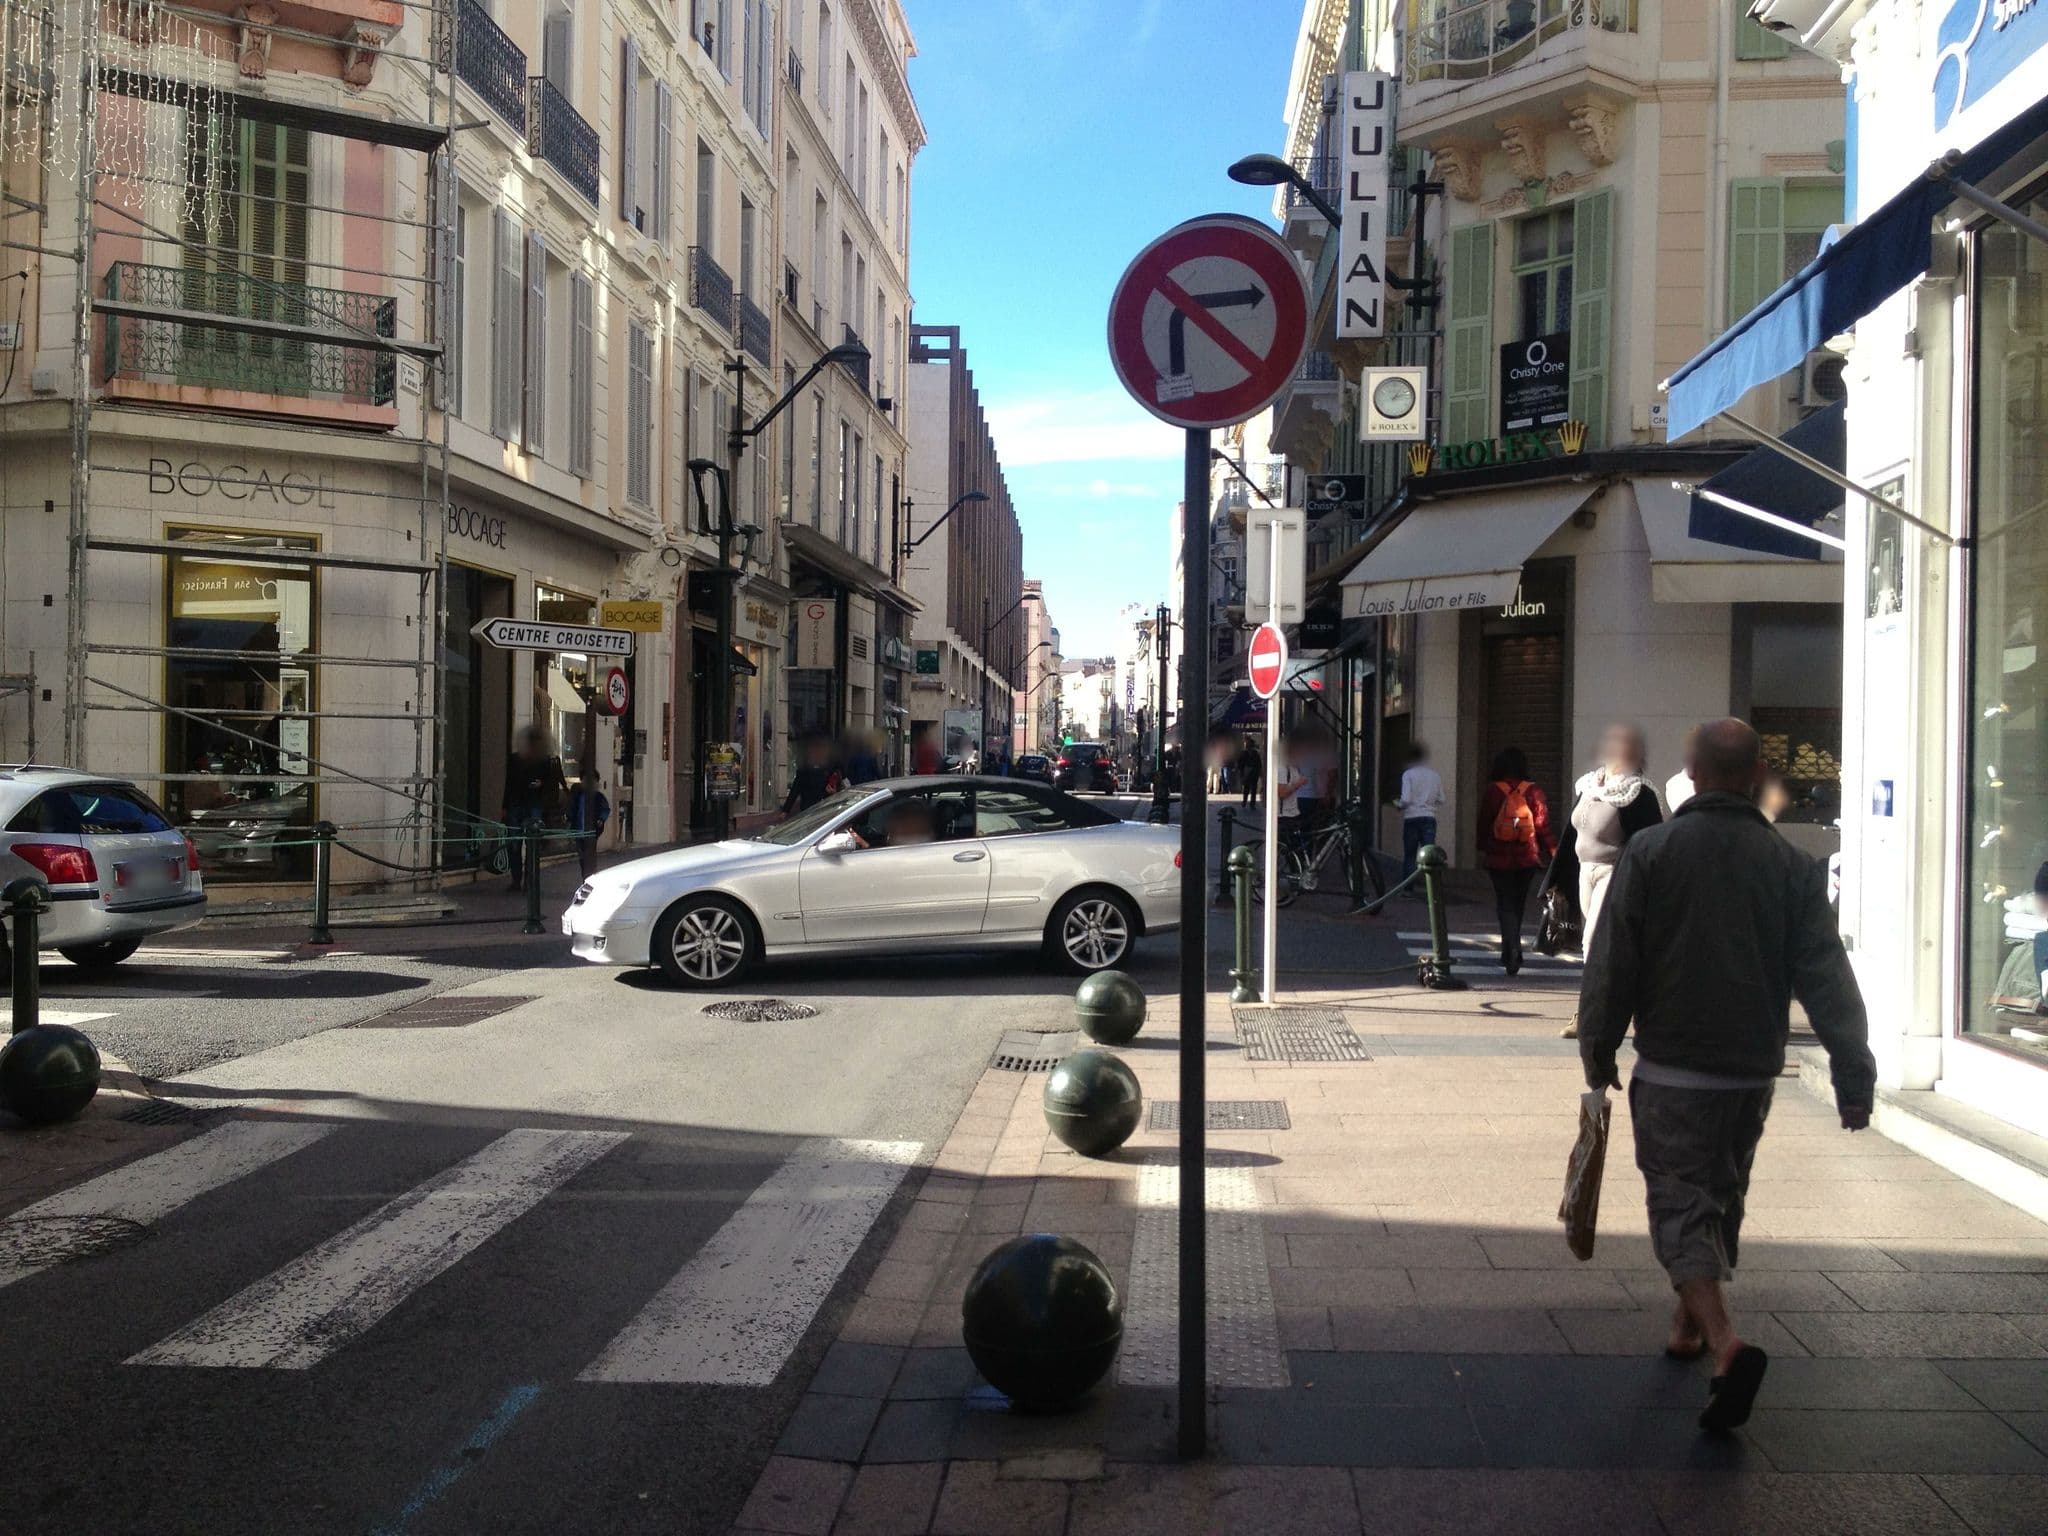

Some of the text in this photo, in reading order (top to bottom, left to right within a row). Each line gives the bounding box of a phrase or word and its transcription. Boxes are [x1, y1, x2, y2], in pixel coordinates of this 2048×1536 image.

[1345, 79, 1384, 329] JULIAN
[1510, 362, 1565, 380] Christy One
[1378, 423, 1409, 431] ROLEX
[1440, 431, 1553, 470] ROLEX
[150, 458, 336, 510] BOCAGE
[448, 502, 507, 550] BOCAGE
[1358, 578, 1487, 615] Louis Julian et Fils
[1500, 584, 1545, 618] Julian
[605, 610, 660, 624] BOCAGE
[498, 626, 626, 650] CENTRE CROISETTE
